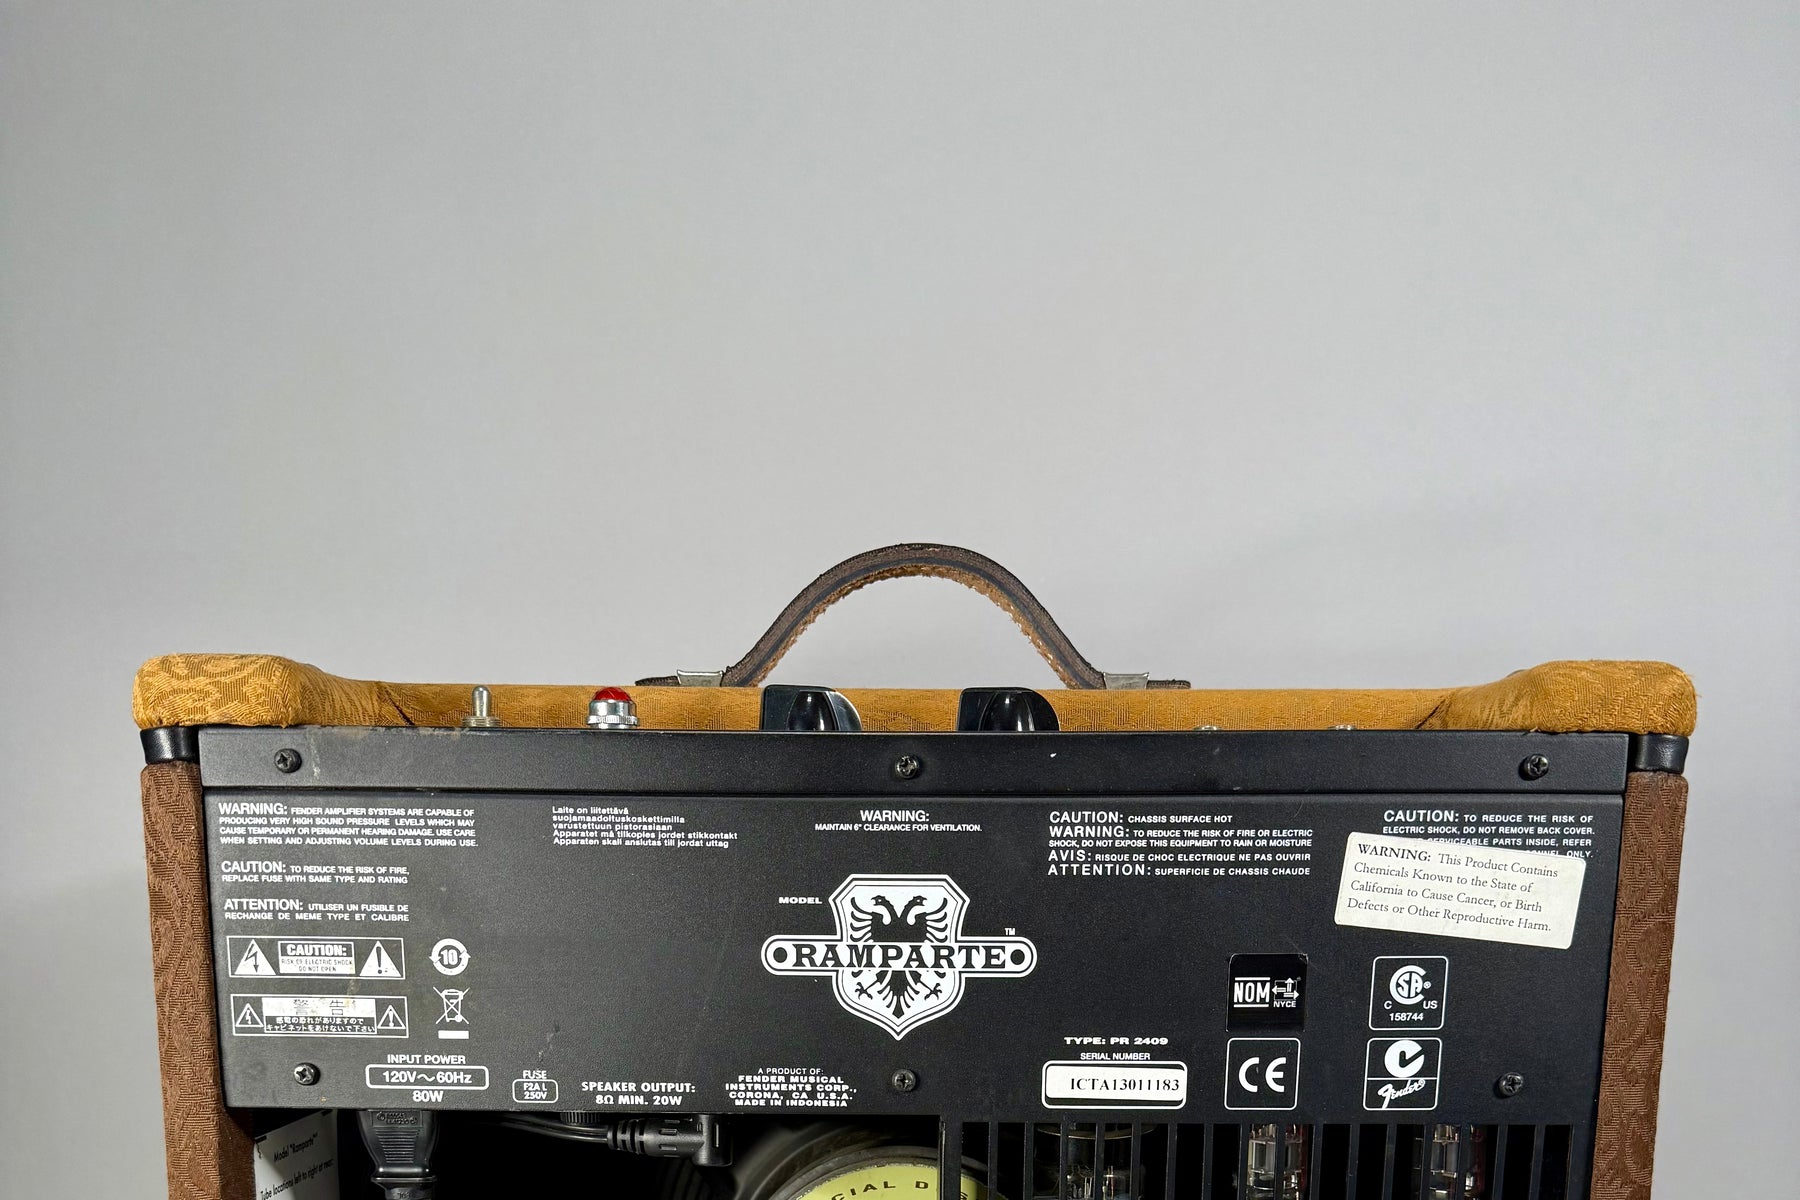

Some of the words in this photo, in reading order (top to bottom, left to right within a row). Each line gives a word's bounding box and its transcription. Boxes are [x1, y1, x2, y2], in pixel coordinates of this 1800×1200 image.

[217, 802, 288, 815] WARNING:
[290, 807, 323, 816] FENDER
[324, 807, 367, 816] AMPLIFIER
[367, 807, 406, 816] SYSTEMS
[407, 808, 424, 816] ARE
[425, 808, 462, 817] CAPABLE
[463, 809, 475, 817] OF
[860, 809, 930, 822] WARNING:
[1049, 811, 1124, 824] CAUTION:
[1127, 815, 1167, 824] CHASSIS
[1169, 815, 1212, 823] SURFACE
[1214, 815, 1233, 823] HOT
[1383, 809, 1459, 823] CAUTION:
[1463, 814, 1477, 823] TO
[1482, 814, 1523, 823] REDUCE
[1527, 815, 1547, 823] THE
[1552, 815, 1575, 823] RISK
[1579, 815, 1594, 823] OF
[814, 823, 853, 831] MAINTAIN
[853, 823, 863, 831] 6"
[863, 823, 911, 832] CLEARANCE
[912, 823, 929, 832] FOR
[929, 824, 983, 832] VENTILATION.
[1049, 825, 1130, 838] WARNING:
[1133, 829, 1145, 838] TO
[1146, 829, 1181, 838] REDUCE
[1182, 829, 1200, 838] THE
[1201, 829, 1221, 838] RISK
[1223, 829, 1235, 838] OF
[1236, 829, 1256, 837] FIRE
[1257, 829, 1271, 837] OR
[1272, 829, 1313, 837] ELECTRIC
[1382, 826, 1425, 834] ELECTRIC
[1427, 826, 1460, 835] SHOCK,
[1462, 826, 1476, 834] DO
[1478, 826, 1497, 834] NOT
[1498, 826, 1535, 835] REMOVE
[1537, 826, 1561, 835] BACK
[1563, 827, 1595, 835] COVER.
[1048, 839, 1080, 848] SHOCK,
[1081, 839, 1095, 848] DO
[1095, 839, 1114, 848] NOT
[1114, 839, 1148, 848] EXPOSE
[1149, 839, 1168, 848] THIS
[1169, 839, 1219, 847] EQUIPMENT
[1219, 839, 1232, 847] TO
[1233, 839, 1253, 847] RAIN
[1254, 839, 1268, 847] OR
[1269, 839, 1313, 847] MOISTURE
[1492, 838, 1523, 846] PARTS
[1525, 838, 1559, 847] INSIDE,
[1562, 838, 1592, 847] REFER
[1048, 849, 1092, 862] AVIS:
[1095, 853, 1130, 862] RISQUE
[1132, 854, 1145, 862] DE
[1147, 853, 1175, 862] CHOC
[1177, 853, 1236, 862] ELECTRIQUE
[1238, 853, 1251, 862] NE
[1254, 853, 1273, 861] PAS
[1275, 853, 1311, 861] OUVRIR
[1358, 843, 1431, 862] WARNING:
[1438, 853, 1461, 866] This
[1465, 856, 1508, 872] Product
[1511, 862, 1558, 878] Contains
[220, 860, 287, 874] CAUTION:
[289, 865, 302, 874] TO
[303, 865, 336, 874] REDUCE
[337, 866, 354, 874] THE
[355, 866, 375, 874] RISK
[375, 866, 388, 874] OF
[389, 866, 410, 876] FIRE,
[1047, 863, 1151, 876] ATTENTION:
[1154, 867, 1210, 876] SUPERFICIE
[1213, 867, 1226, 876] DE
[1228, 867, 1269, 876] CHASSIS
[1271, 867, 1311, 876] CHAUDE
[1354, 862, 1409, 878] Chemicals
[1412, 868, 1453, 883] Known
[1456, 876, 1468, 885] to
[1471, 875, 1488, 888] the
[1490, 877, 1517, 891] State
[1520, 882, 1534, 893] of
[778, 896, 823, 905] MODEL
[1350, 880, 1403, 896] California
[1407, 888, 1419, 897] to
[1421, 888, 1454, 902] Cause
[1456, 892, 1497, 909] Cancer,
[1500, 900, 1513, 909] or
[1515, 899, 1542, 913] Birth
[223, 898, 304, 911] ATTENTION:
[308, 903, 344, 912] UTILISER
[346, 903, 359, 912] UN
[361, 904, 395, 912] FUSIBLE
[397, 904, 409, 913] DE
[1347, 897, 1389, 912] Defects
[1392, 906, 1405, 914] or
[1407, 904, 1441, 918] Other
[1442, 908, 1515, 927] Reproductive
[1517, 917, 1551, 932] Harm.
[286, 943, 347, 957] CAUTION:
[792, 943, 1006, 969] RAMPARTE
[439, 948, 459, 965] 10
[1233, 982, 1271, 1003] NOM
[1273, 1000, 1297, 1008] NYCE
[1423, 1000, 1438, 1010] US
[1389, 1012, 1424, 1022] 158744
[1063, 1037, 1106, 1045] TYPE:
[1110, 1037, 1130, 1045] PR
[1134, 1037, 1169, 1046] 2409
[387, 1054, 422, 1064] INPUT
[424, 1054, 466, 1065] POWER
[1080, 1052, 1111, 1061] SERIAL
[1112, 1052, 1151, 1061] NUMBER
[522, 1069, 548, 1080] FUSE
[757, 1067, 764, 1075] A
[766, 1067, 807, 1075] PRODUCT
[738, 1075, 786, 1083] FENDER
[789, 1075, 844, 1084] MUSICAL
[1071, 1078, 1180, 1091] ICTA13011183
[581, 1081, 637, 1092] SPEAKER
[640, 1082, 696, 1093] OUTPUT:
[725, 1083, 812, 1094] INSTRUMENTS
[816, 1084, 857, 1093] CORP.,
[412, 1090, 444, 1103] 80W
[524, 1091, 548, 1100] 250V
[595, 1094, 615, 1105] 8Ω
[618, 1094, 649, 1105] MIN.
[652, 1095, 683, 1106] 20W
[728, 1091, 784, 1101] CORONA,
[791, 1091, 812, 1101] CA
[816, 1092, 853, 1101] U.S.A.
[770, 1098, 783, 1106] IN
[786, 1099, 848, 1107] INDONESIA
